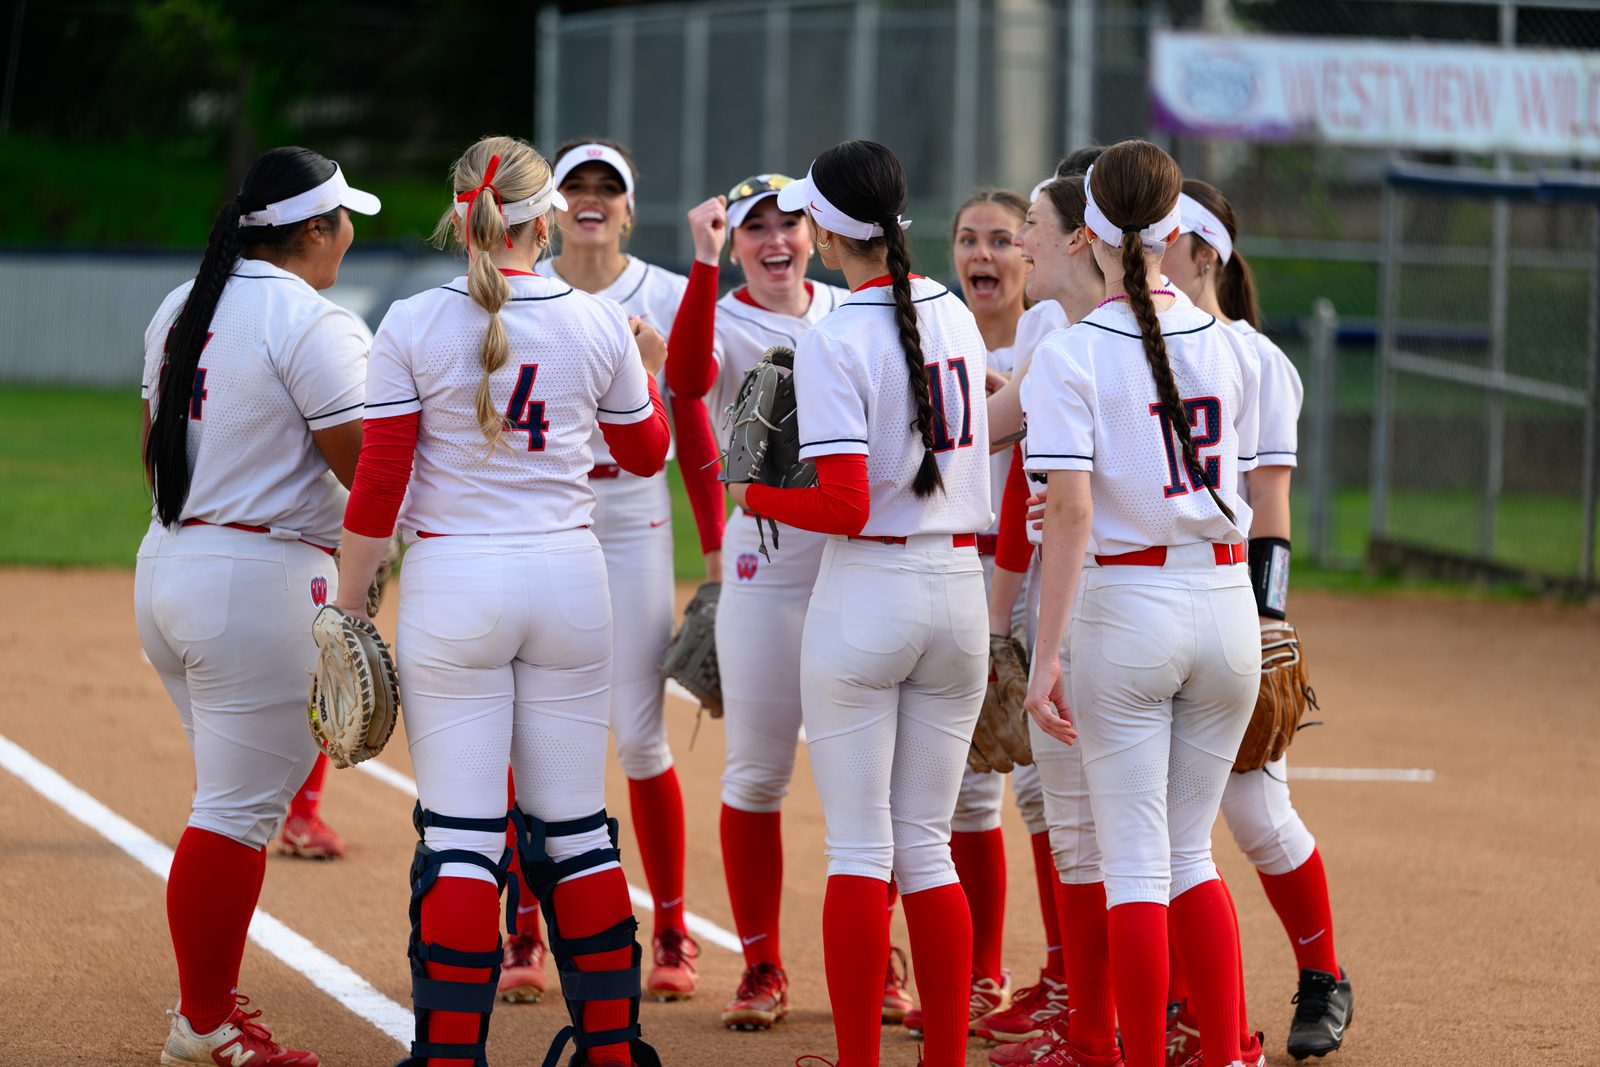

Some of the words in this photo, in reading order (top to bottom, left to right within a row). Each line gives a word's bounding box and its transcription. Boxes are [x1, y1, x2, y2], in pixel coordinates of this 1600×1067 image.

[1279, 58, 1498, 132] WESTVIEW
[502, 363, 550, 452] 4
[924, 356, 973, 453] 11
[1148, 396, 1222, 498] 12
